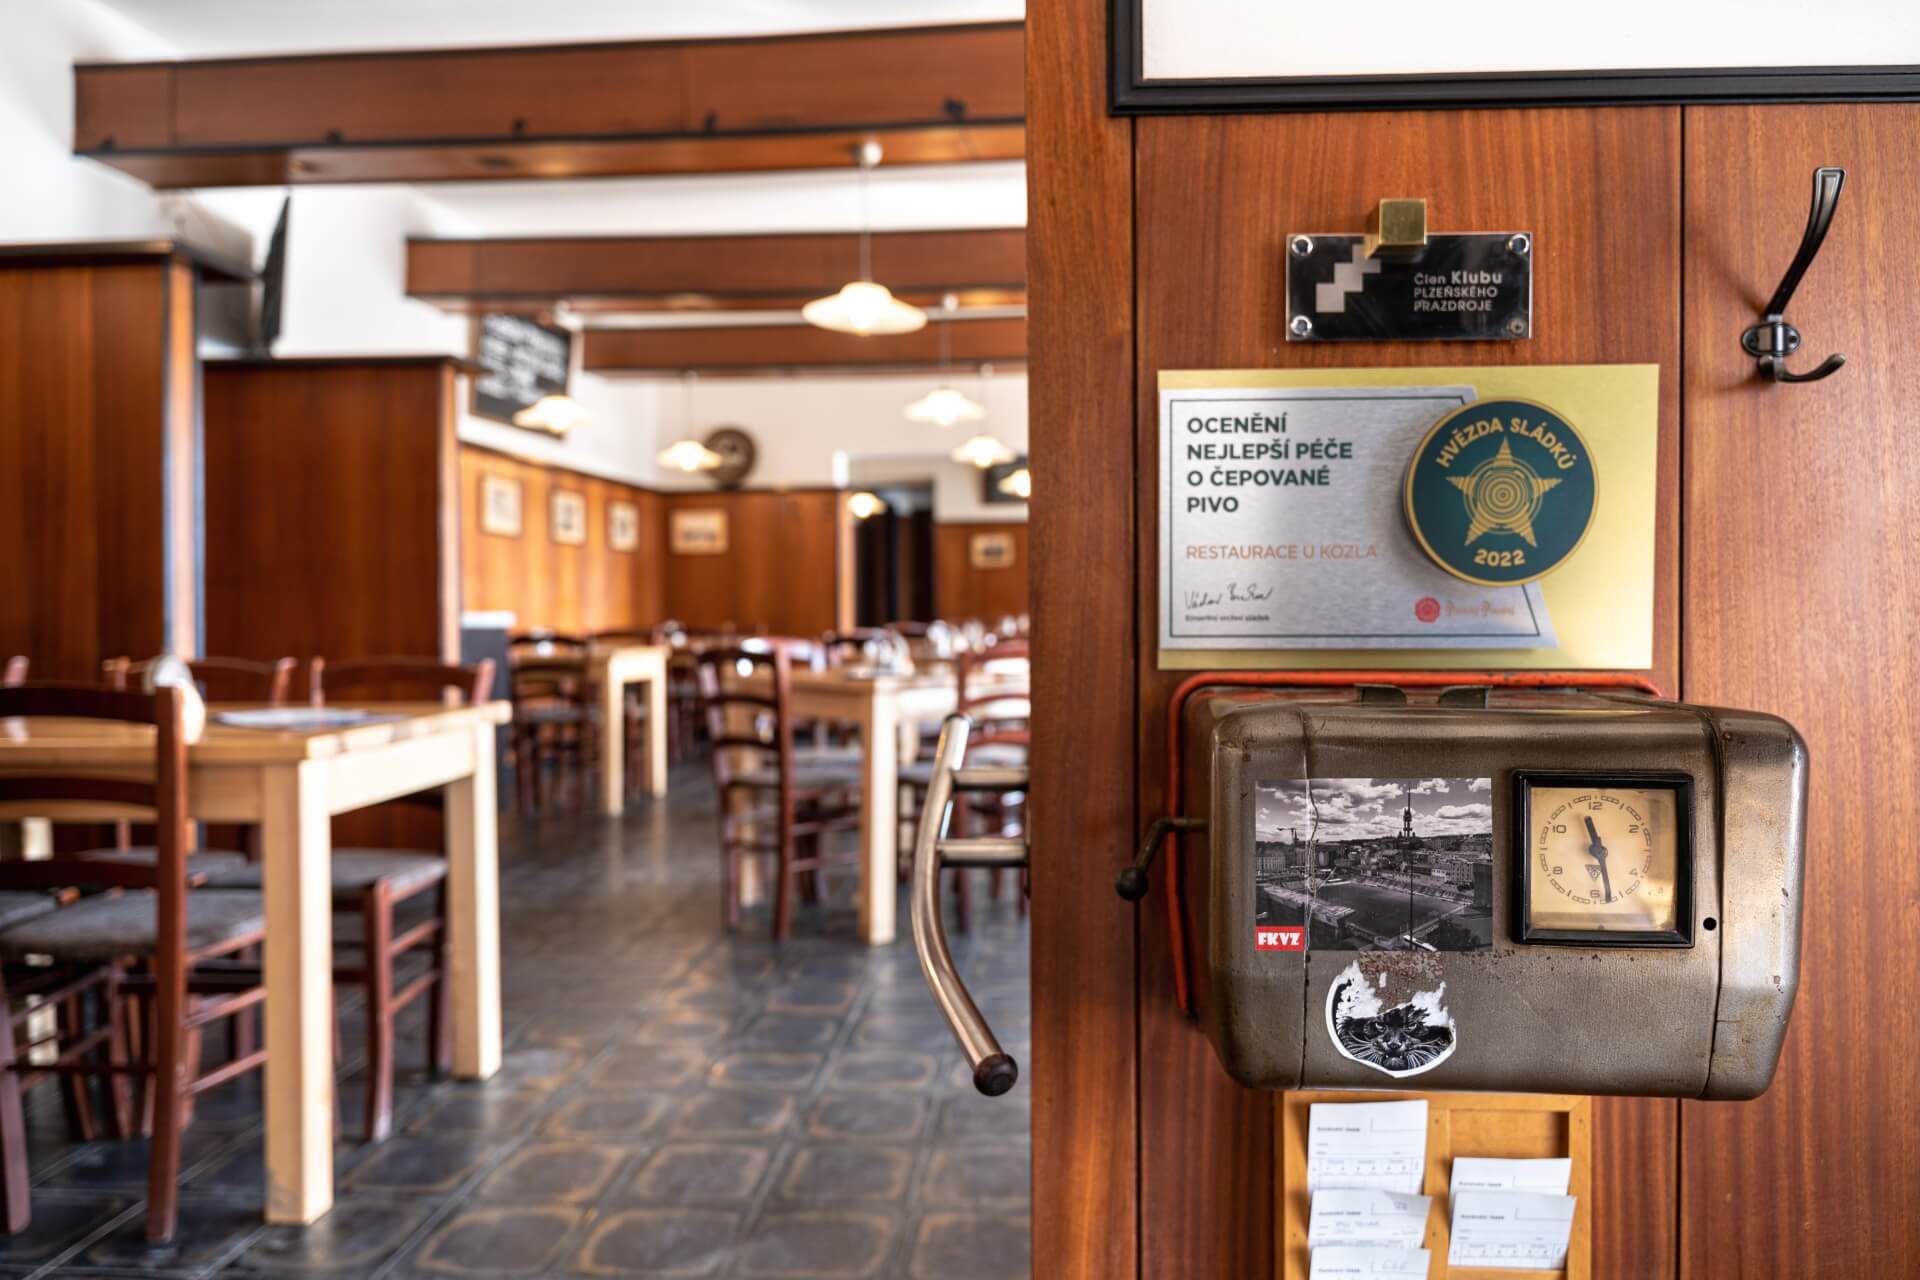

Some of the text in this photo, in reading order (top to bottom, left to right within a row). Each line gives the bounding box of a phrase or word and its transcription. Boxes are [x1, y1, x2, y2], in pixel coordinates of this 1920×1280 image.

[1451, 270, 1503, 284] Klubu
[1414, 285, 1499, 298] PLZEŇSKÉHO
[1414, 299, 1493, 312] PRAZDROJE
[1187, 412, 1288, 434] OCENĚNÍ
[1187, 438, 1353, 460] NEJLEPŠÍ PÉČE
[1435, 417, 1577, 470] HVĚZDA SLÁDKŮ
[1187, 465, 1331, 487] O ČEPOVANÉ
[1187, 496, 1239, 513] PIVO
[1186, 544, 1378, 560] RESTAURACE U KOZLA
[1474, 548, 1526, 567] 2022
[1588, 802, 1603, 811] 12
[1552, 824, 1567, 834] 10
[1628, 824, 1640, 834] 2
[1552, 866, 1564, 875] 8
[1629, 868, 1638, 877] 4
[1589, 889, 1601, 898] 6
[1257, 932, 1301, 946] FKVZ
